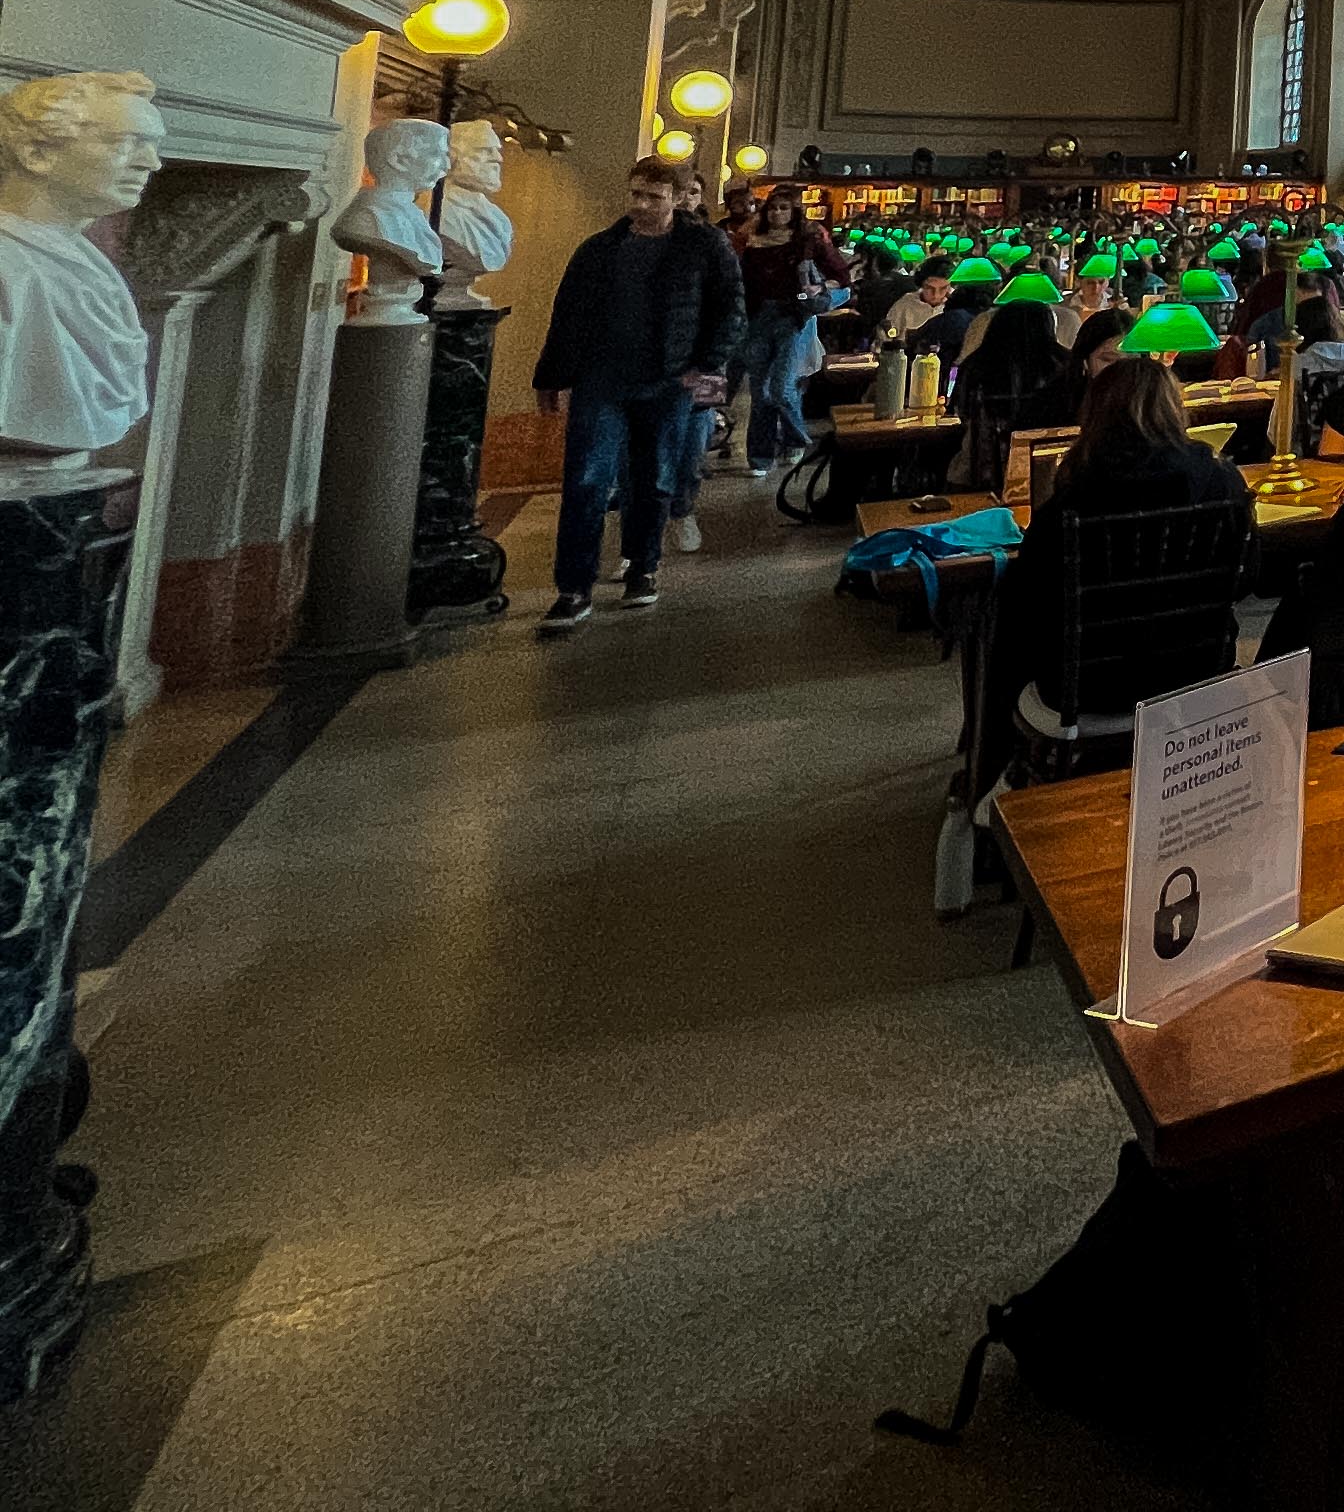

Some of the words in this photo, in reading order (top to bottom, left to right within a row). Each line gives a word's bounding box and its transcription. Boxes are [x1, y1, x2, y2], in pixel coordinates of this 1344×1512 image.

[1162, 742, 1223, 783] personal
[1226, 731, 1262, 755] items
[1165, 740, 1185, 758] Do
[1188, 728, 1211, 749] not
[1214, 716, 1249, 739] leave
[1161, 754, 1244, 801] unattended.
